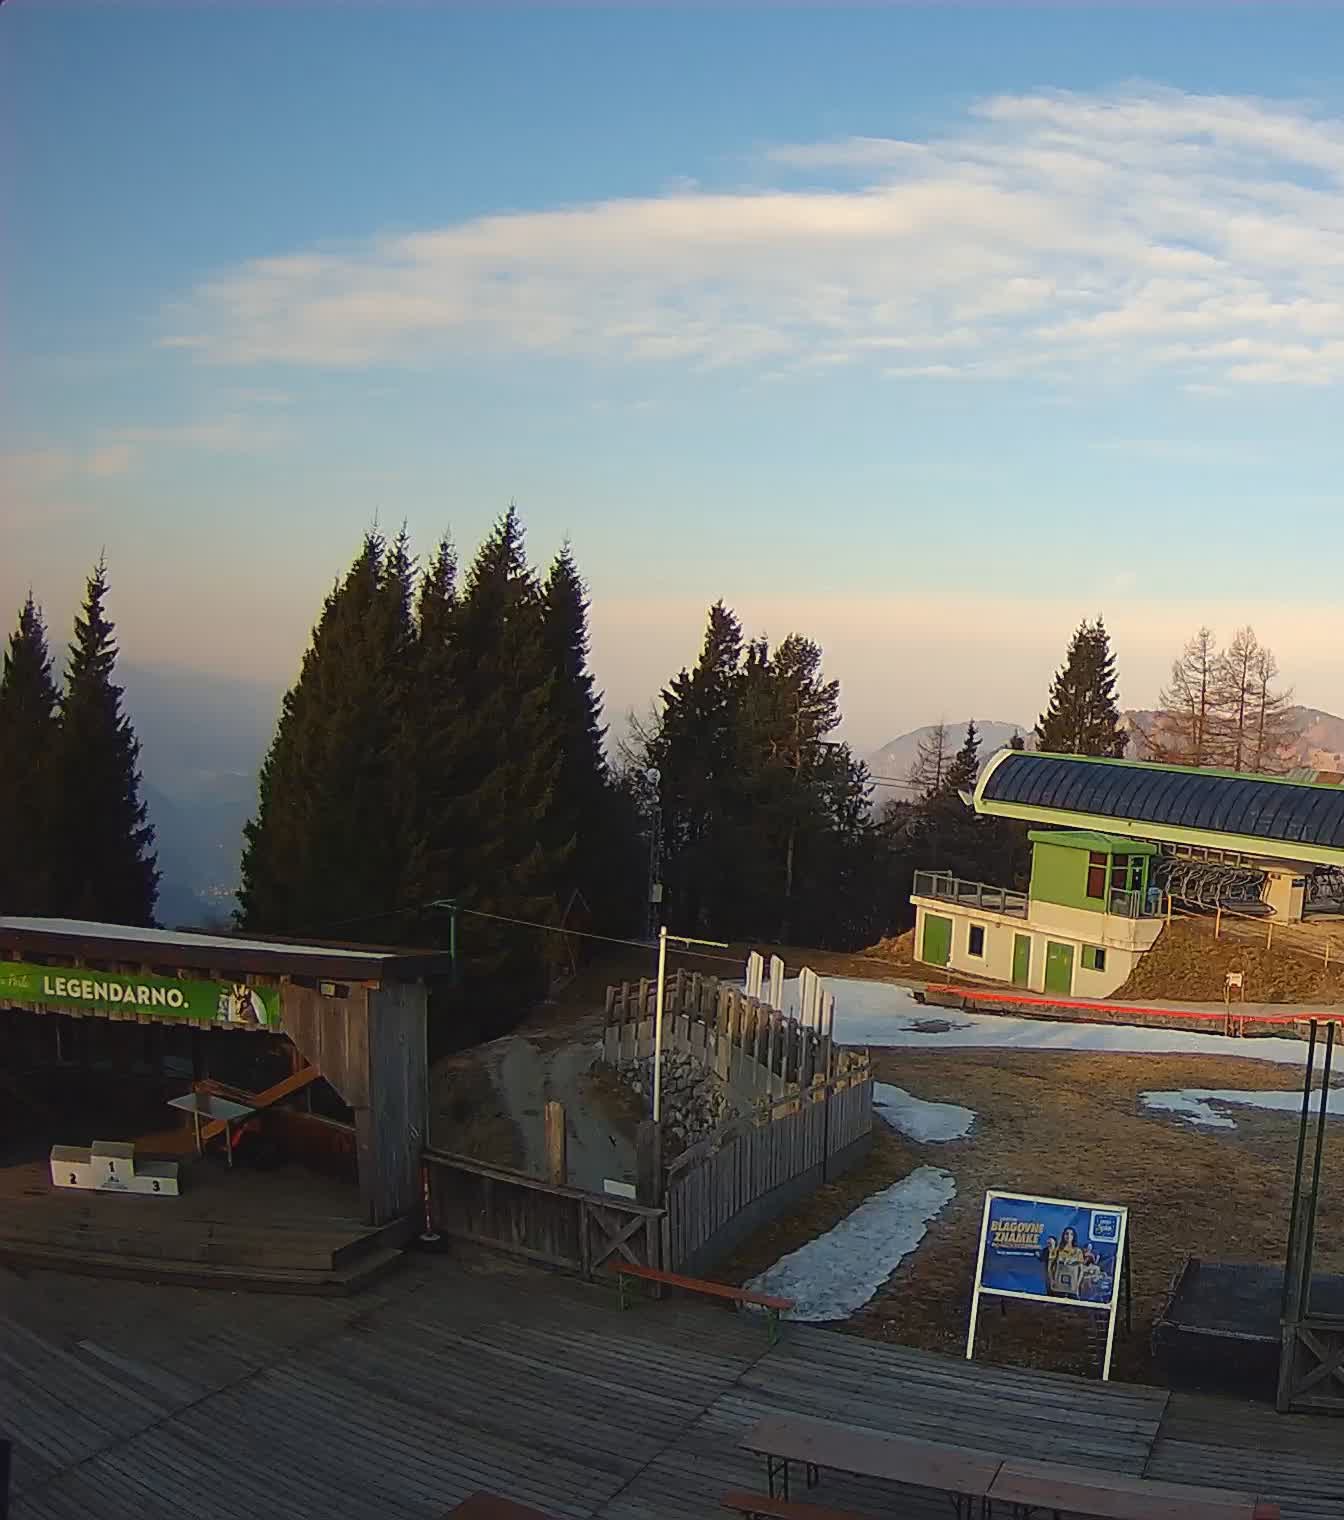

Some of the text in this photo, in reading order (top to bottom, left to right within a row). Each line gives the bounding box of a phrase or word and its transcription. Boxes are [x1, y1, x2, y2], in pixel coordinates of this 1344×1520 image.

[44, 976, 189, 1009] LEGENDARNO.
[108, 1161, 115, 1172] 1
[69, 1173, 77, 1184] 2
[152, 1180, 160, 1192] 3
